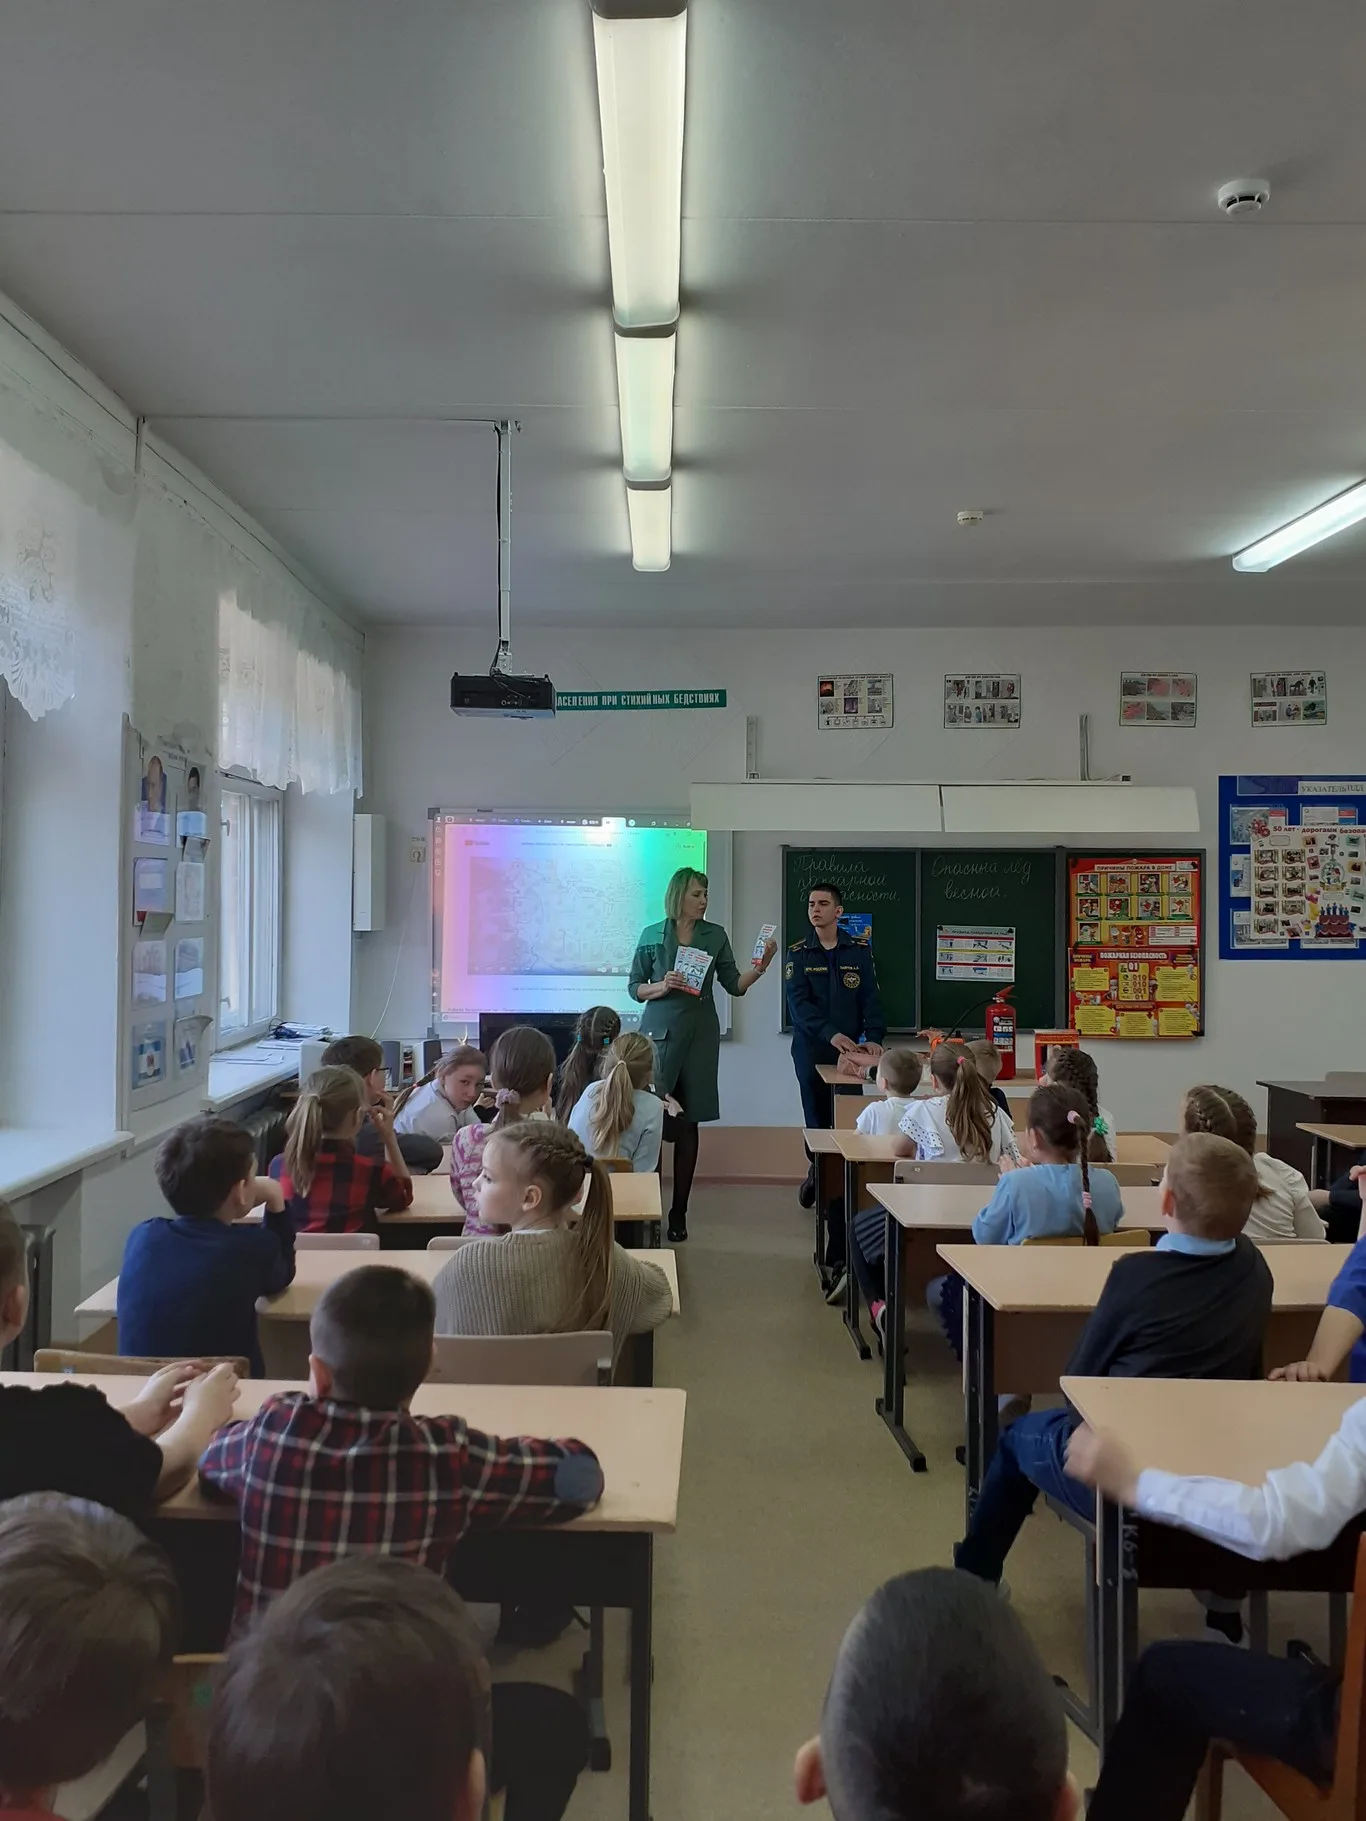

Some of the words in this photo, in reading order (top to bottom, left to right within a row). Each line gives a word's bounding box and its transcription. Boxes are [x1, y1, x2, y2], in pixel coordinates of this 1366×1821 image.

[557, 695, 598, 707] АСЕЛЕНИЯ
[601, 695, 618, 706] ПРИ
[620, 693, 670, 706] СТИХИЙНЫХ
[673, 692, 720, 705] БЕДСТВИЯХ
[1128, 962, 1138, 971] 01
